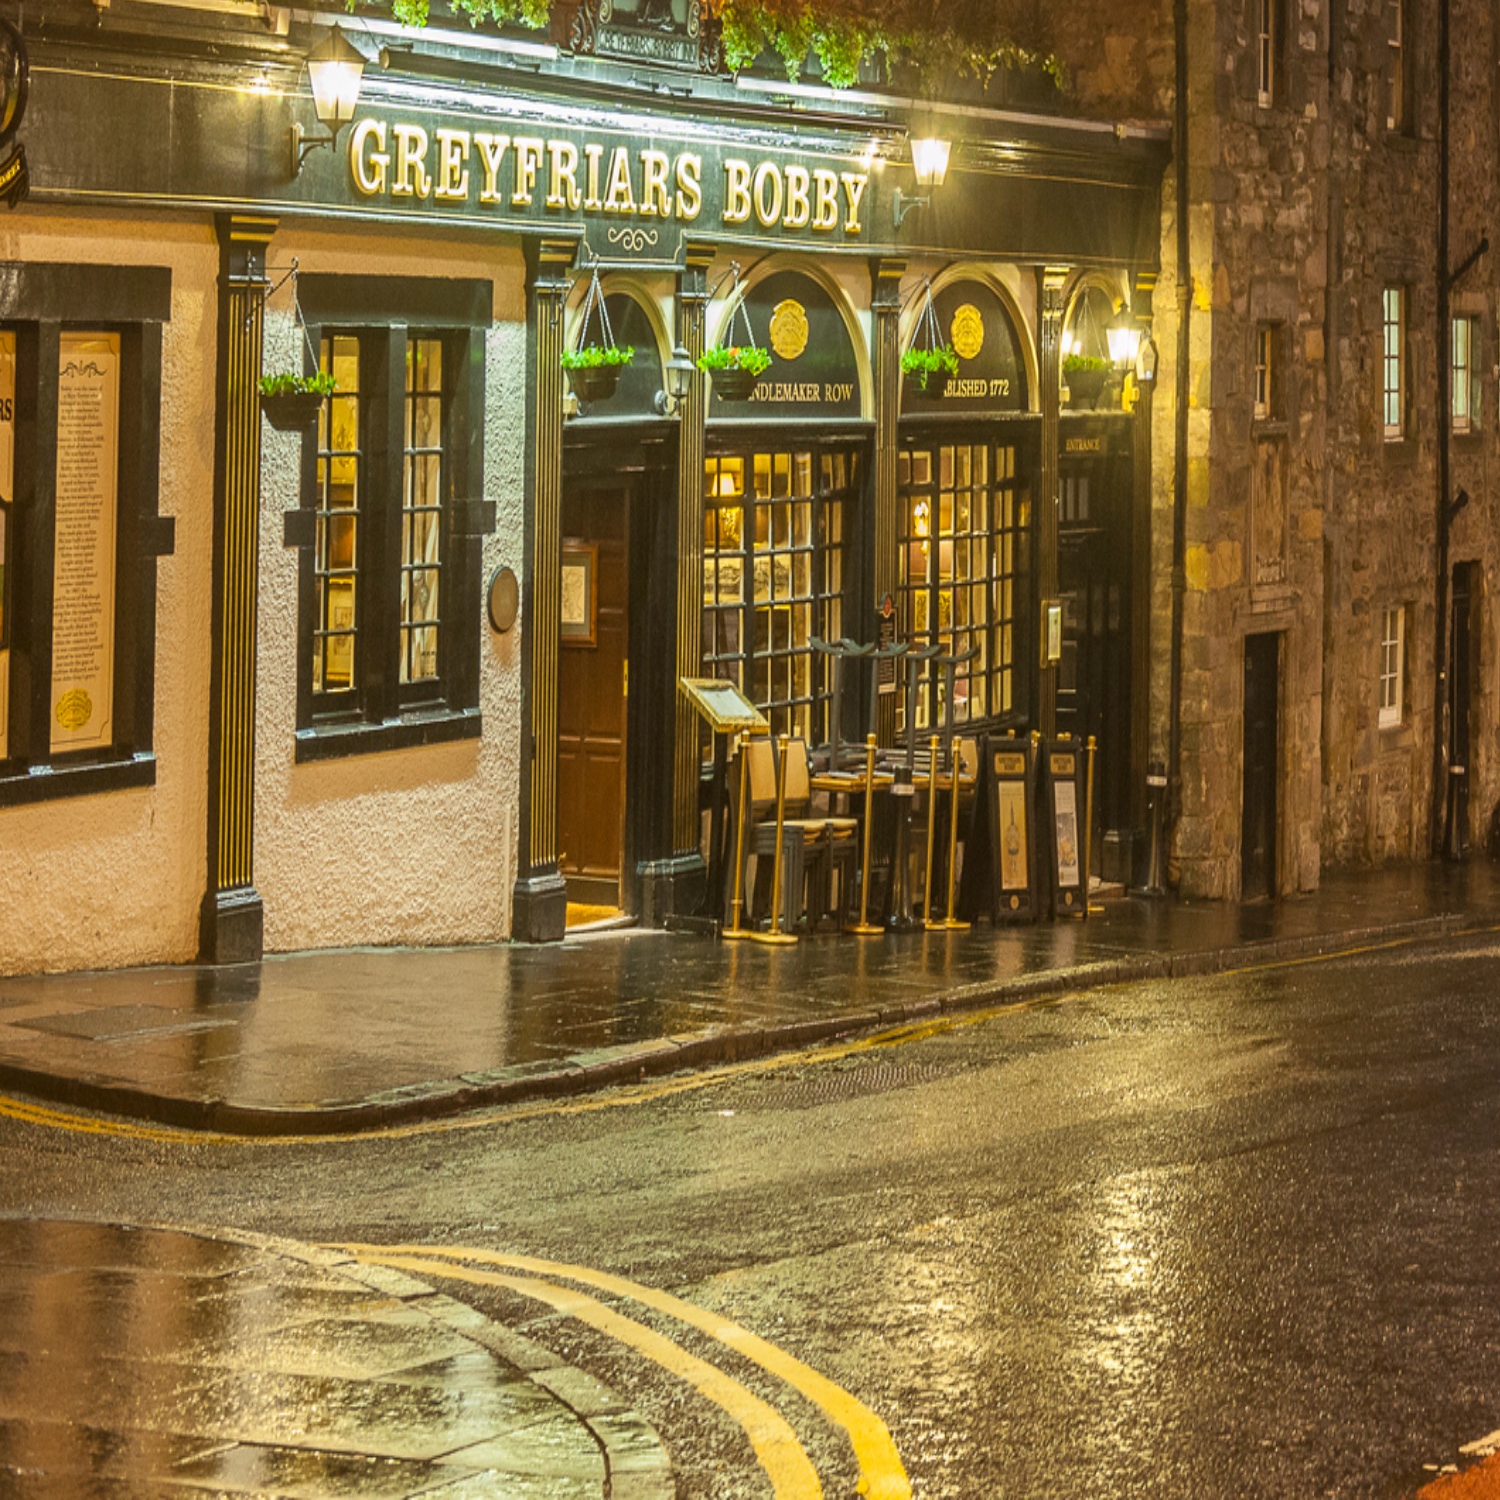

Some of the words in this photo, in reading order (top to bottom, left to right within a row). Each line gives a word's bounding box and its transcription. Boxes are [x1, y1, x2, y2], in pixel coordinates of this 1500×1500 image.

[348, 118, 702, 220] GREYFRIARS
[723, 158, 867, 233] BOBBY
[748, 381, 821, 402] NDLEMAKER
[825, 384, 853, 402] ROW
[989, 379, 1010, 396] 1772
[1066, 438, 1099, 451] ENTRANCE
